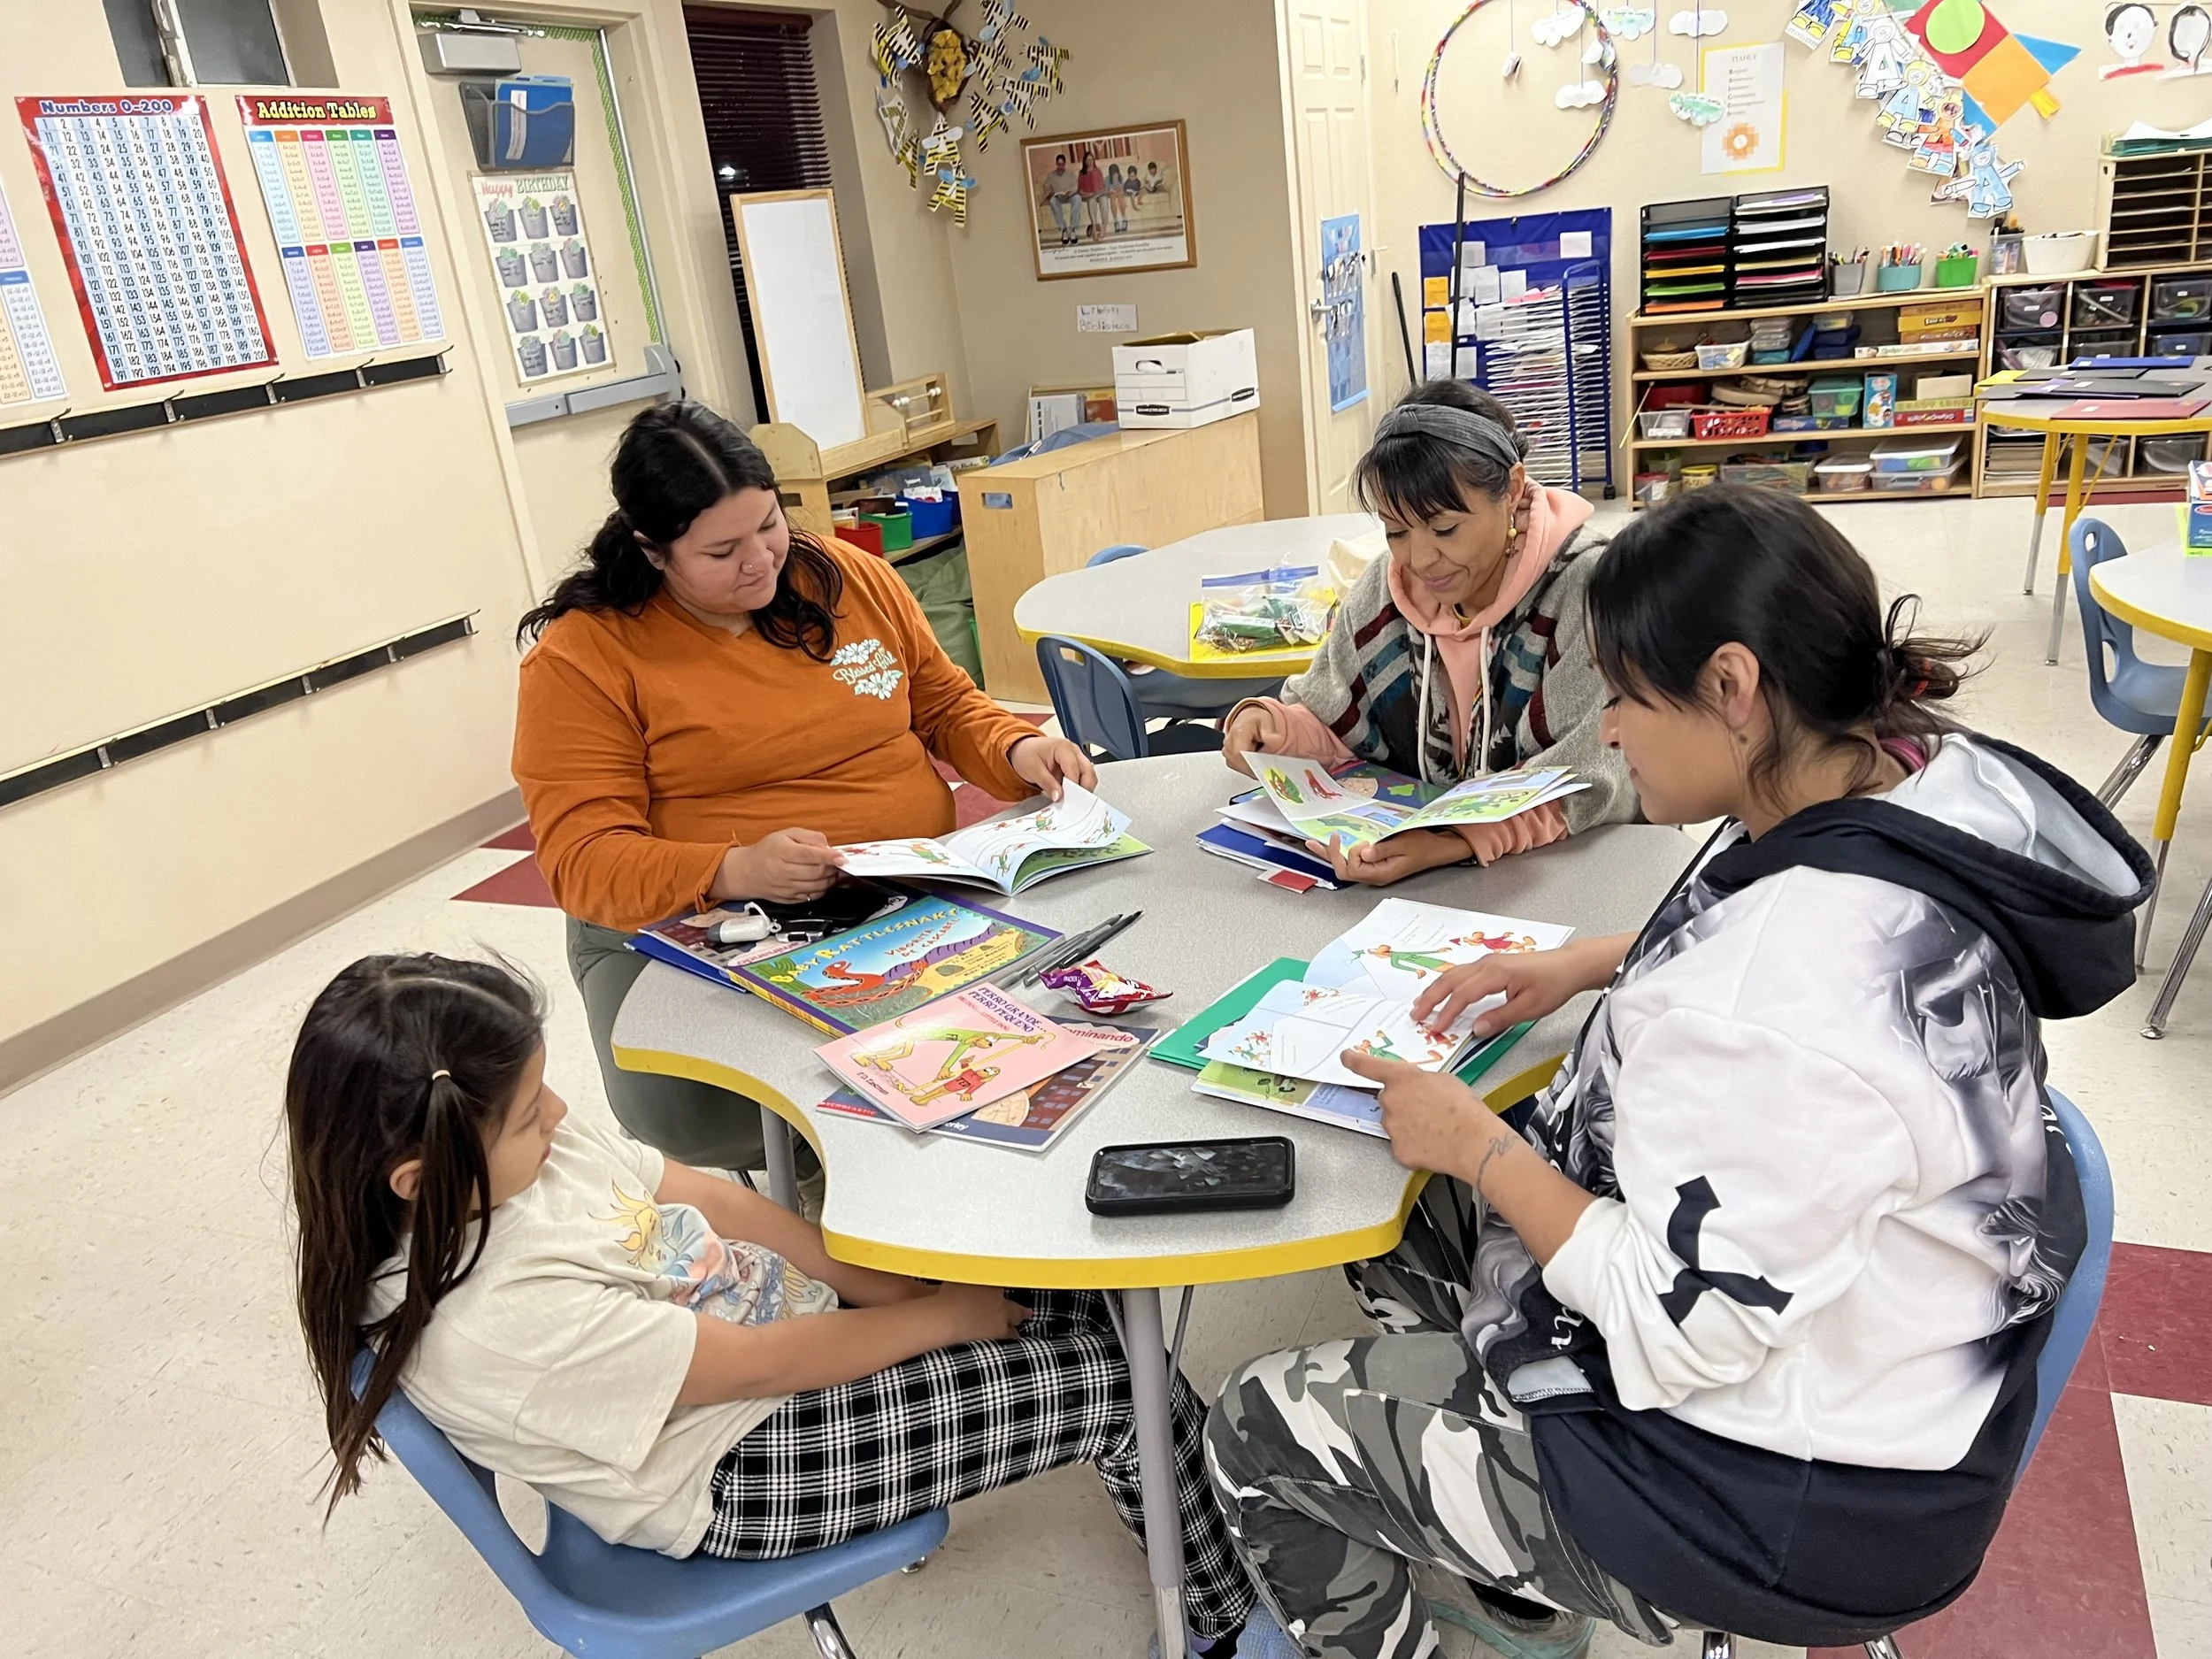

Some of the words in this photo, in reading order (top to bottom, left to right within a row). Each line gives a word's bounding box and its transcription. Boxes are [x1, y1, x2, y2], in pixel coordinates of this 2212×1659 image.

[40, 99, 117, 114] Numbers
[120, 98, 173, 113] 0-200
[256, 101, 326, 119] Addition
[326, 101, 377, 119] Tables
[44, 132, 53, 142] 11
[62, 131, 73, 142] 12
[80, 131, 90, 142] 13
[97, 131, 106, 140] 14
[113, 130, 123, 140] 15
[130, 129, 140, 140] 16
[147, 129, 154, 139] 17
[163, 129, 172, 139] 18
[178, 129, 186, 138] 19
[193, 129, 202, 138] 20
[66, 145, 78, 156] 22
[83, 144, 95, 155] 23
[101, 144, 111, 154] 24
[117, 143, 127, 154] 25
[134, 143, 143, 153] 26
[150, 142, 158, 152] 27
[166, 142, 175, 152] 28
[181, 142, 191, 151] 29
[196, 142, 205, 151] 30
[71, 158, 81, 169] 32
[88, 157, 98, 168] 33
[104, 157, 115, 167] 34
[121, 156, 131, 166] 35
[138, 156, 148, 166] 36
[154, 156, 162, 165] 37
[170, 155, 180, 165] 38
[185, 154, 194, 165] 39
[201, 154, 209, 163] 40
[58, 173, 67, 182] 41
[76, 173, 85, 182] 42
[93, 172, 103, 181] 43
[110, 171, 119, 180] 44
[126, 170, 135, 180] 45
[142, 170, 151, 179] 46
[158, 168, 166, 178] 47
[174, 168, 183, 177] 48
[189, 167, 198, 177] 49
[204, 166, 212, 177] 50
[62, 186, 71, 197] 51
[79, 186, 89, 196] 52
[96, 185, 106, 195] 53
[113, 184, 122, 194] 54
[129, 182, 139, 193] 55
[145, 182, 155, 192] 56
[161, 180, 170, 191] 57
[177, 180, 187, 190] 58
[193, 180, 202, 189] 59
[208, 180, 216, 189] 60
[481, 182, 513, 199] Happy
[515, 176, 569, 193] BIRTHDAY
[66, 199, 75, 211] 61
[83, 199, 93, 209] 62
[101, 198, 110, 208] 63
[117, 197, 127, 207] 64
[134, 196, 143, 206] 65
[150, 195, 159, 205] 66
[165, 194, 173, 204] 67
[181, 193, 191, 203] 68
[196, 193, 205, 202] 69
[211, 192, 219, 202] 70
[69, 212, 79, 224] 71
[87, 212, 97, 223] 72
[104, 211, 114, 221] 73
[120, 211, 130, 220] 74
[136, 209, 147, 219] 75
[152, 208, 163, 218] 76
[168, 207, 177, 217] 77
[184, 206, 195, 216] 78
[200, 205, 209, 214] 79
[214, 204, 223, 214] 80
[74, 227, 83, 237] 81
[90, 226, 101, 235] 82
[108, 225, 118, 234] 83
[124, 224, 134, 234] 84
[140, 222, 150, 232] 85
[157, 221, 166, 231] 86
[173, 219, 180, 230] 87
[188, 219, 198, 228] 88
[204, 218, 212, 227] 89
[218, 217, 227, 226] 90
[78, 241, 88, 250] 91
[95, 239, 105, 250] 92
[111, 237, 122, 248] 93
[127, 236, 138, 246] 94
[144, 235, 154, 245] 95
[161, 234, 170, 243] 96
[176, 232, 184, 242] 97
[192, 232, 202, 241] 98
[207, 230, 216, 240] 99
[220, 229, 232, 239] 100
[80, 253, 92, 264] 101
[97, 252, 111, 262] 102
[113, 250, 127, 261] 103
[131, 250, 142, 258] 104
[147, 248, 159, 257] 105
[163, 247, 175, 257] 106
[178, 245, 189, 255] 107
[195, 244, 206, 253] 108
[209, 242, 220, 252] 109
[225, 242, 234, 250] 110
[115, 370, 127, 380] 191
[131, 368, 144, 378] 192
[148, 365, 160, 375] 193
[164, 364, 176, 373] 194
[180, 361, 191, 372] 195
[196, 359, 207, 368] 196
[211, 357, 221, 366] 197
[226, 354, 237, 364] 198
[241, 352, 251, 362] 199
[253, 350, 266, 360] 200
[833, 661, 876, 686] Blessed
[968, 991, 997, 1010] PERRO
[979, 987, 1007, 1006] PERRO
[1063, 1025, 1133, 1042] minando
[826, 1101, 877, 1117] SCHOLASTIC
